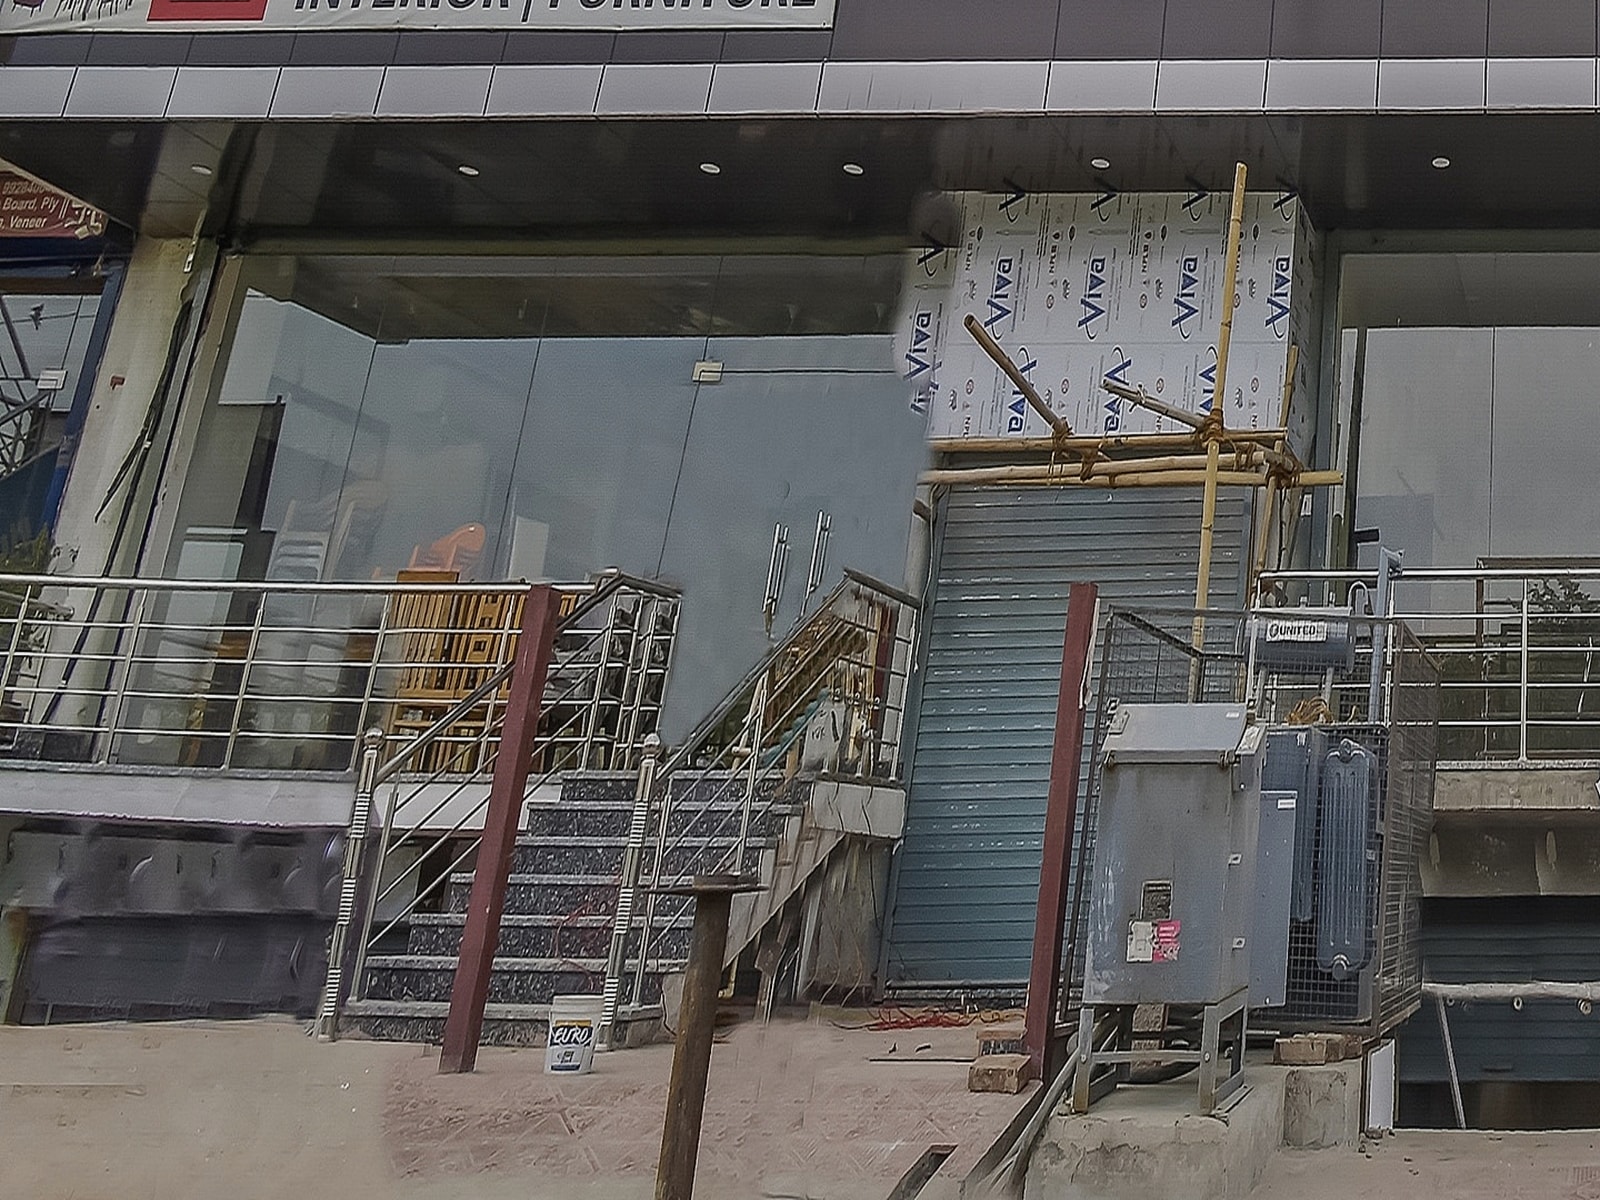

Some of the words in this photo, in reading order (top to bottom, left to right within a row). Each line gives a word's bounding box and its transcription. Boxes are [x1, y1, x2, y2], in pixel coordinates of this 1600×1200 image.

[1078, 256, 1106, 328] Viva
[1172, 256, 1199, 328] Viva
[1265, 256, 1291, 328] Viva
[553, 1026, 589, 1044] EURO
